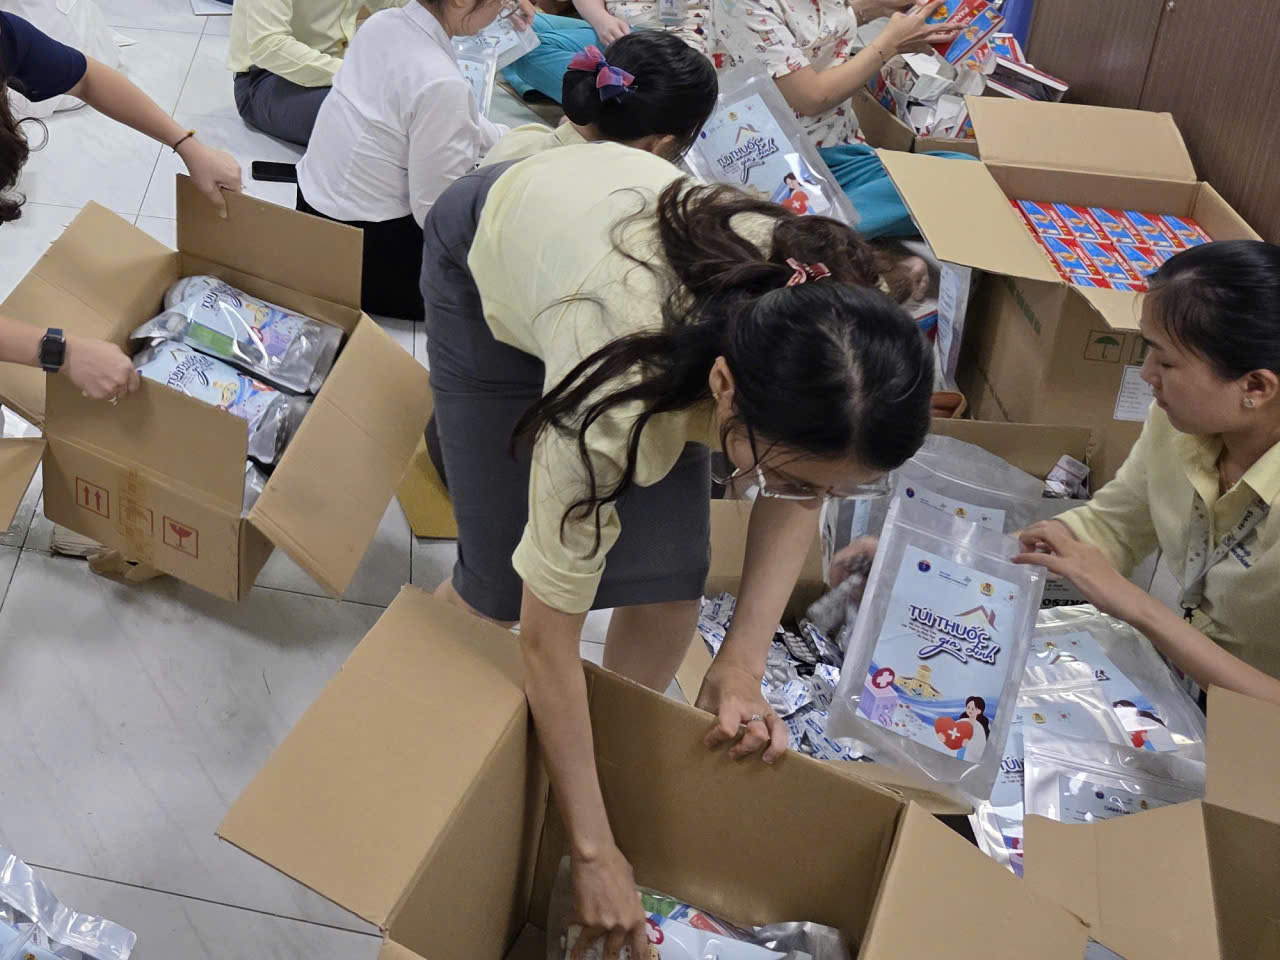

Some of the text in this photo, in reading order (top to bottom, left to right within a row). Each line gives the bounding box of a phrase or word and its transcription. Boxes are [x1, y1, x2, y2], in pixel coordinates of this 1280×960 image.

[908, 604, 934, 627] TÚI
[935, 615, 989, 644] THUỐC
[918, 637, 967, 663] gia
